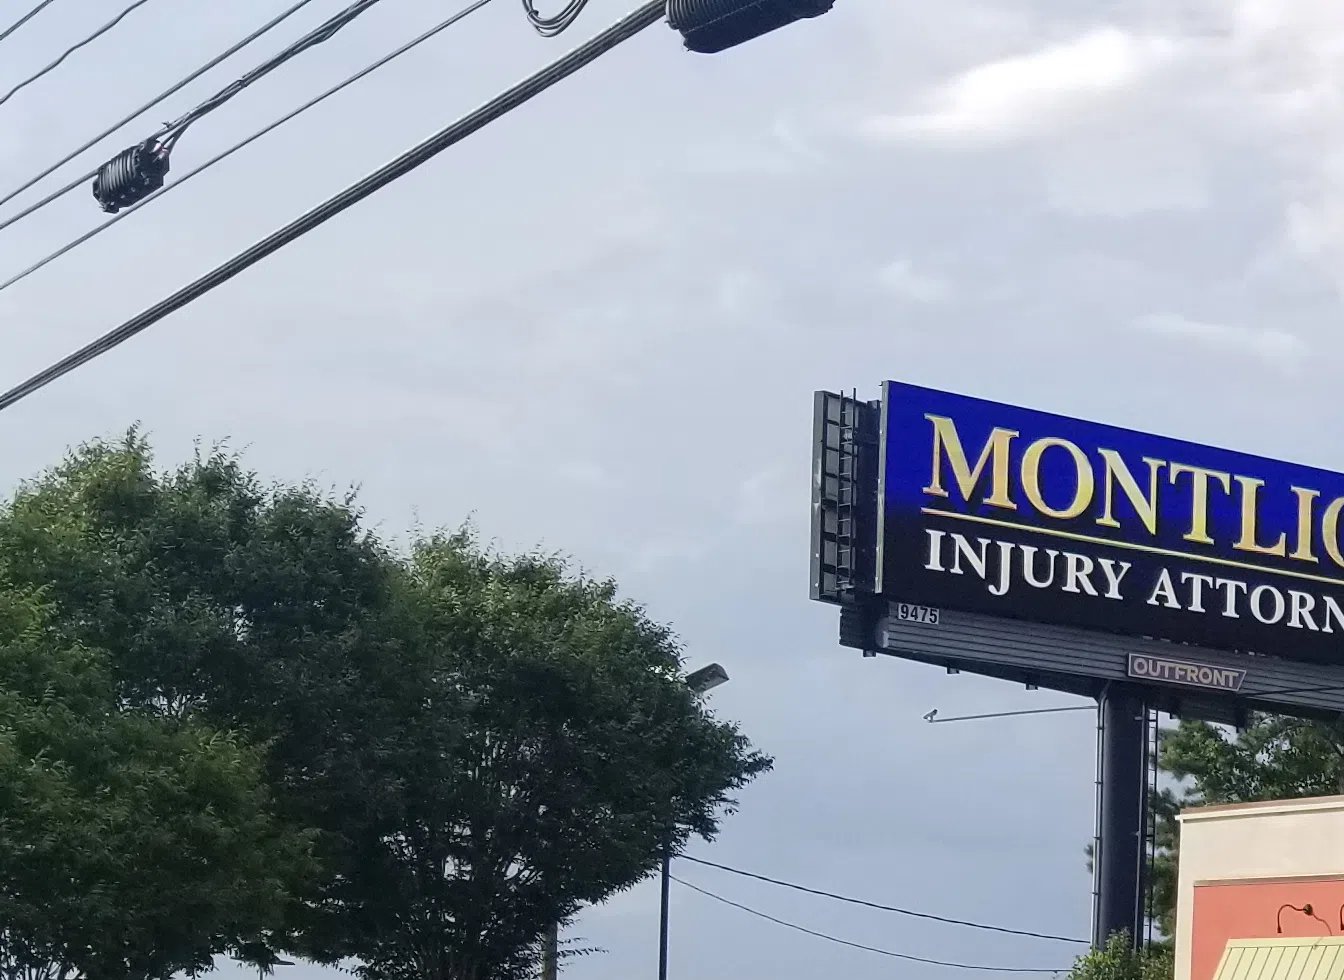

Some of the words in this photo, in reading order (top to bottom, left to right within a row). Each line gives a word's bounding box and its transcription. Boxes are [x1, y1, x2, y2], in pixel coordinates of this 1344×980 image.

[924, 528, 1132, 601] INJURY
[900, 604, 938, 624] 9475
[1133, 657, 1239, 688] OUTFRONT
